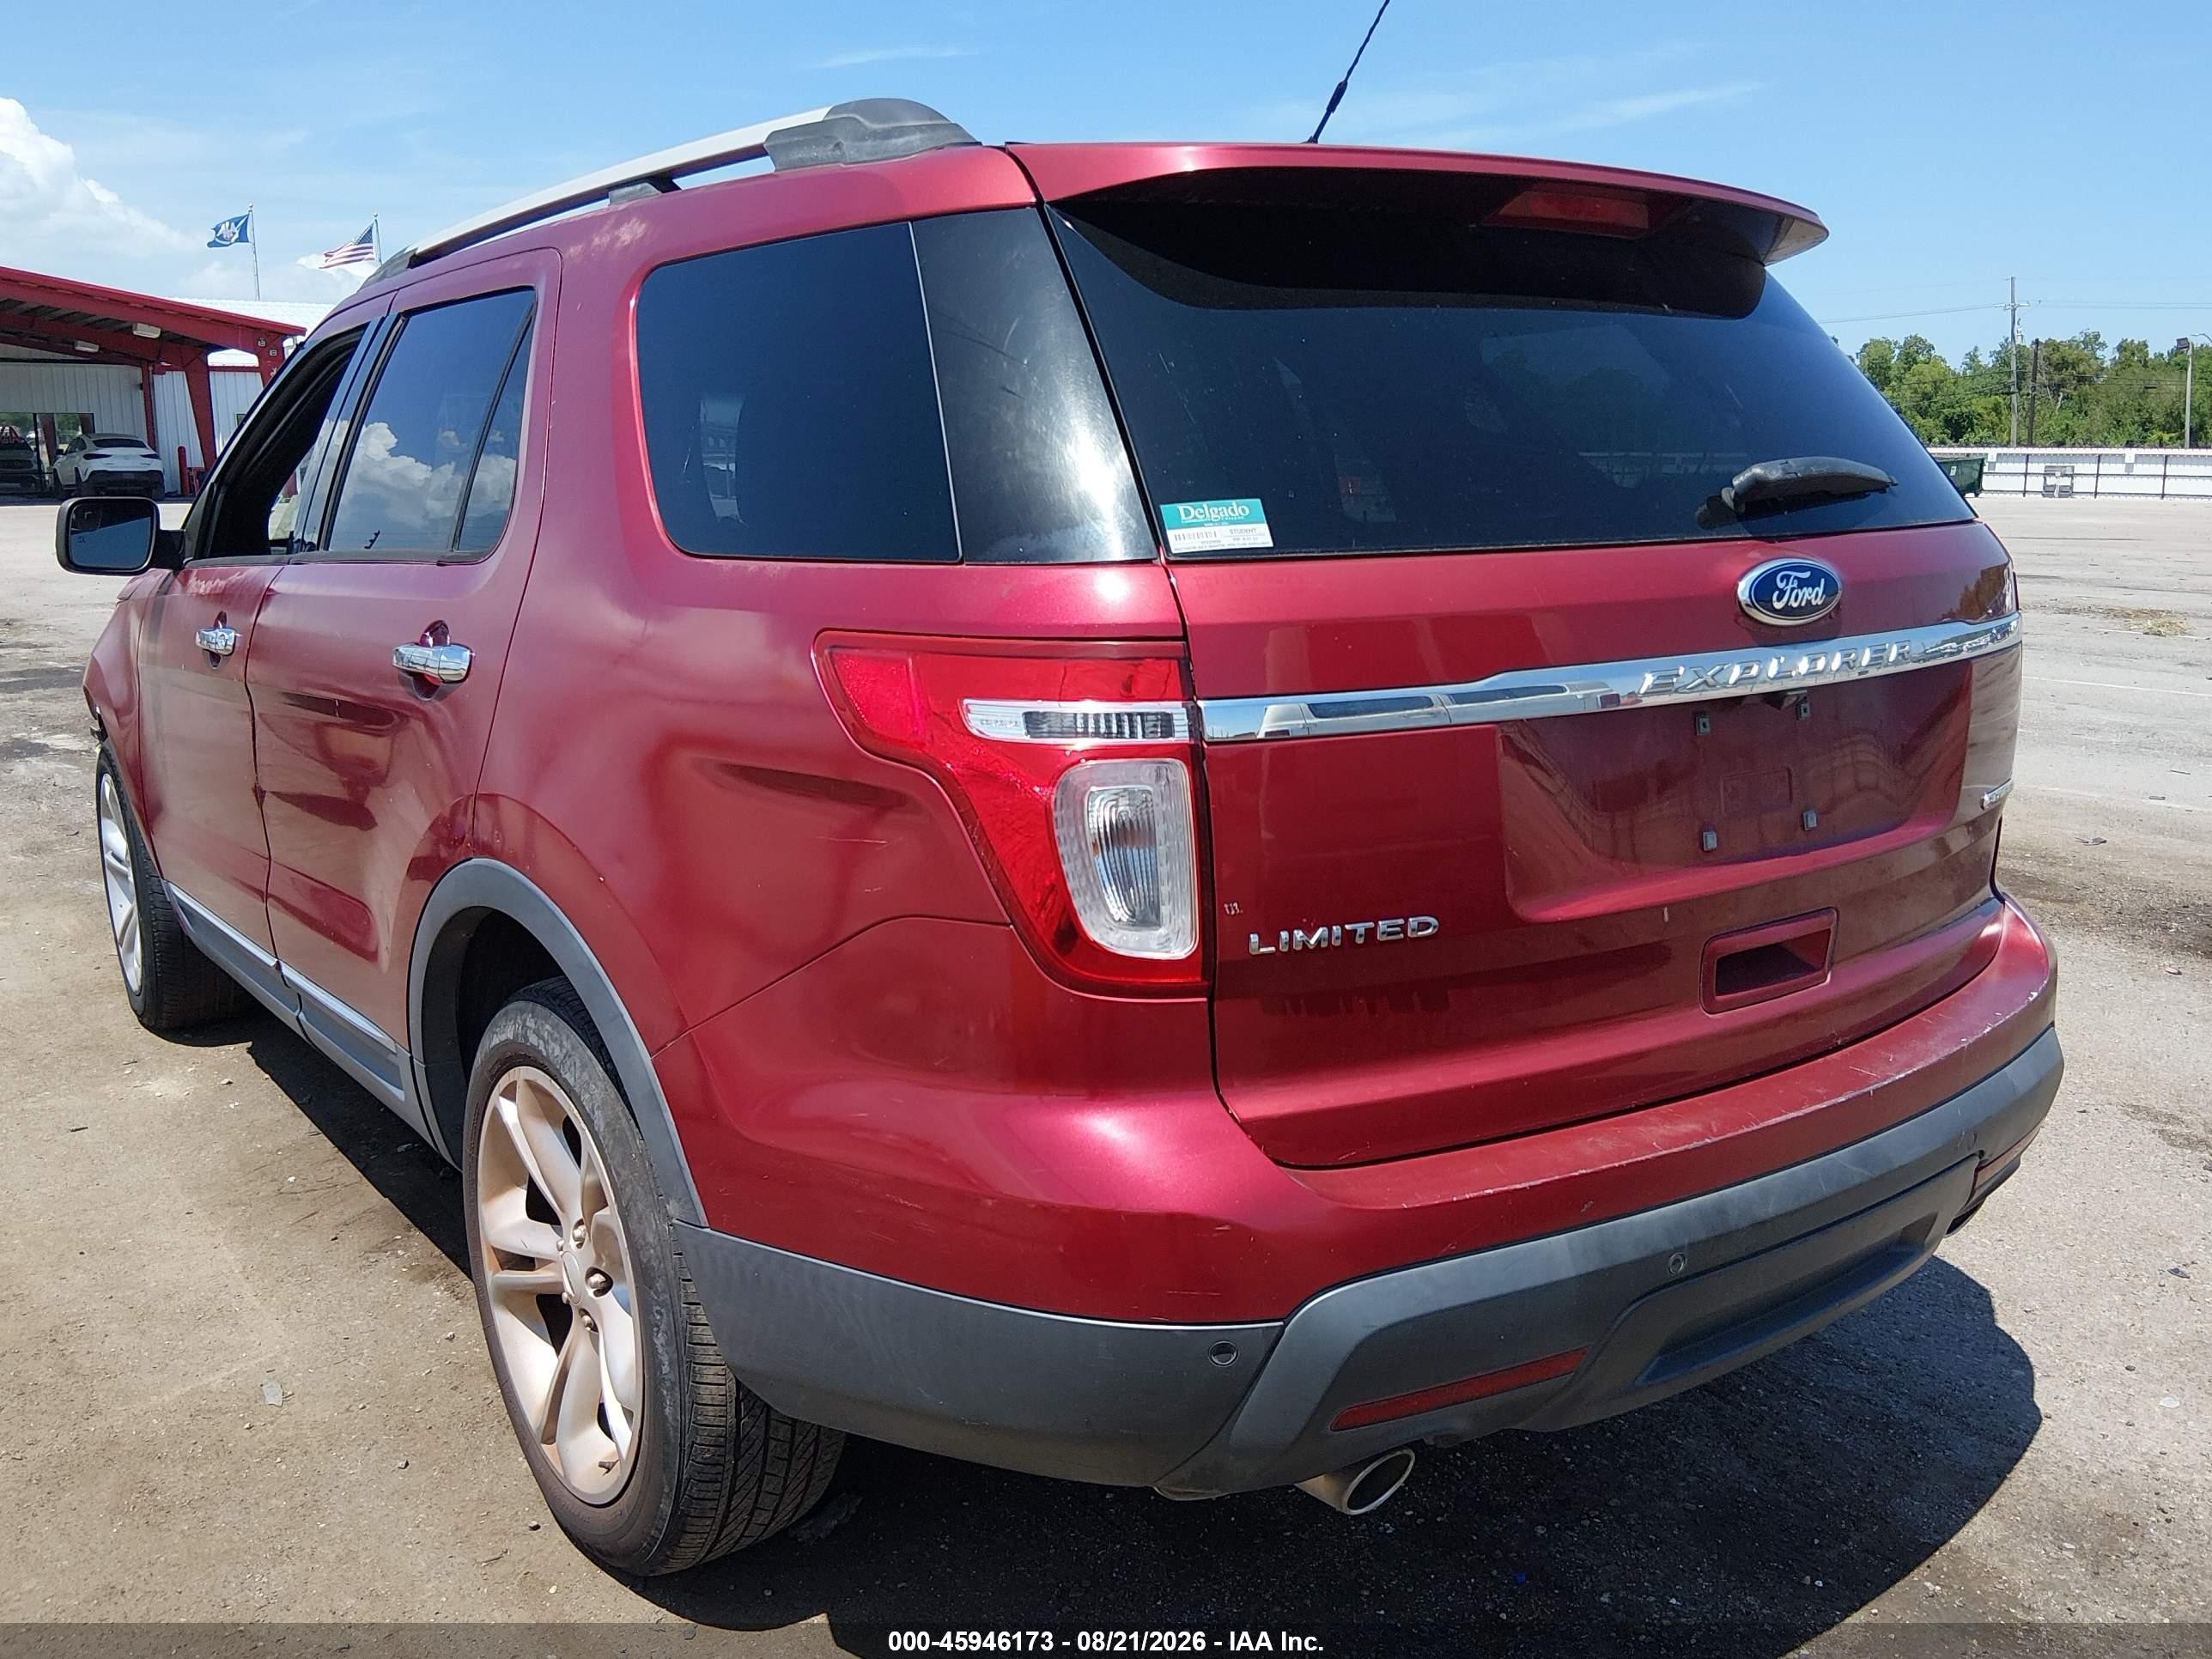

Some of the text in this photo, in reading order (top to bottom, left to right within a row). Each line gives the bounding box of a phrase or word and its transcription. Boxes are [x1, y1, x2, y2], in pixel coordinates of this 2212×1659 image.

[1177, 501, 1250, 522] Delgado
[1772, 570, 1826, 610] Ford
[1638, 640, 1911, 695] EXPLORER
[1249, 915, 1440, 955] LIMITED
